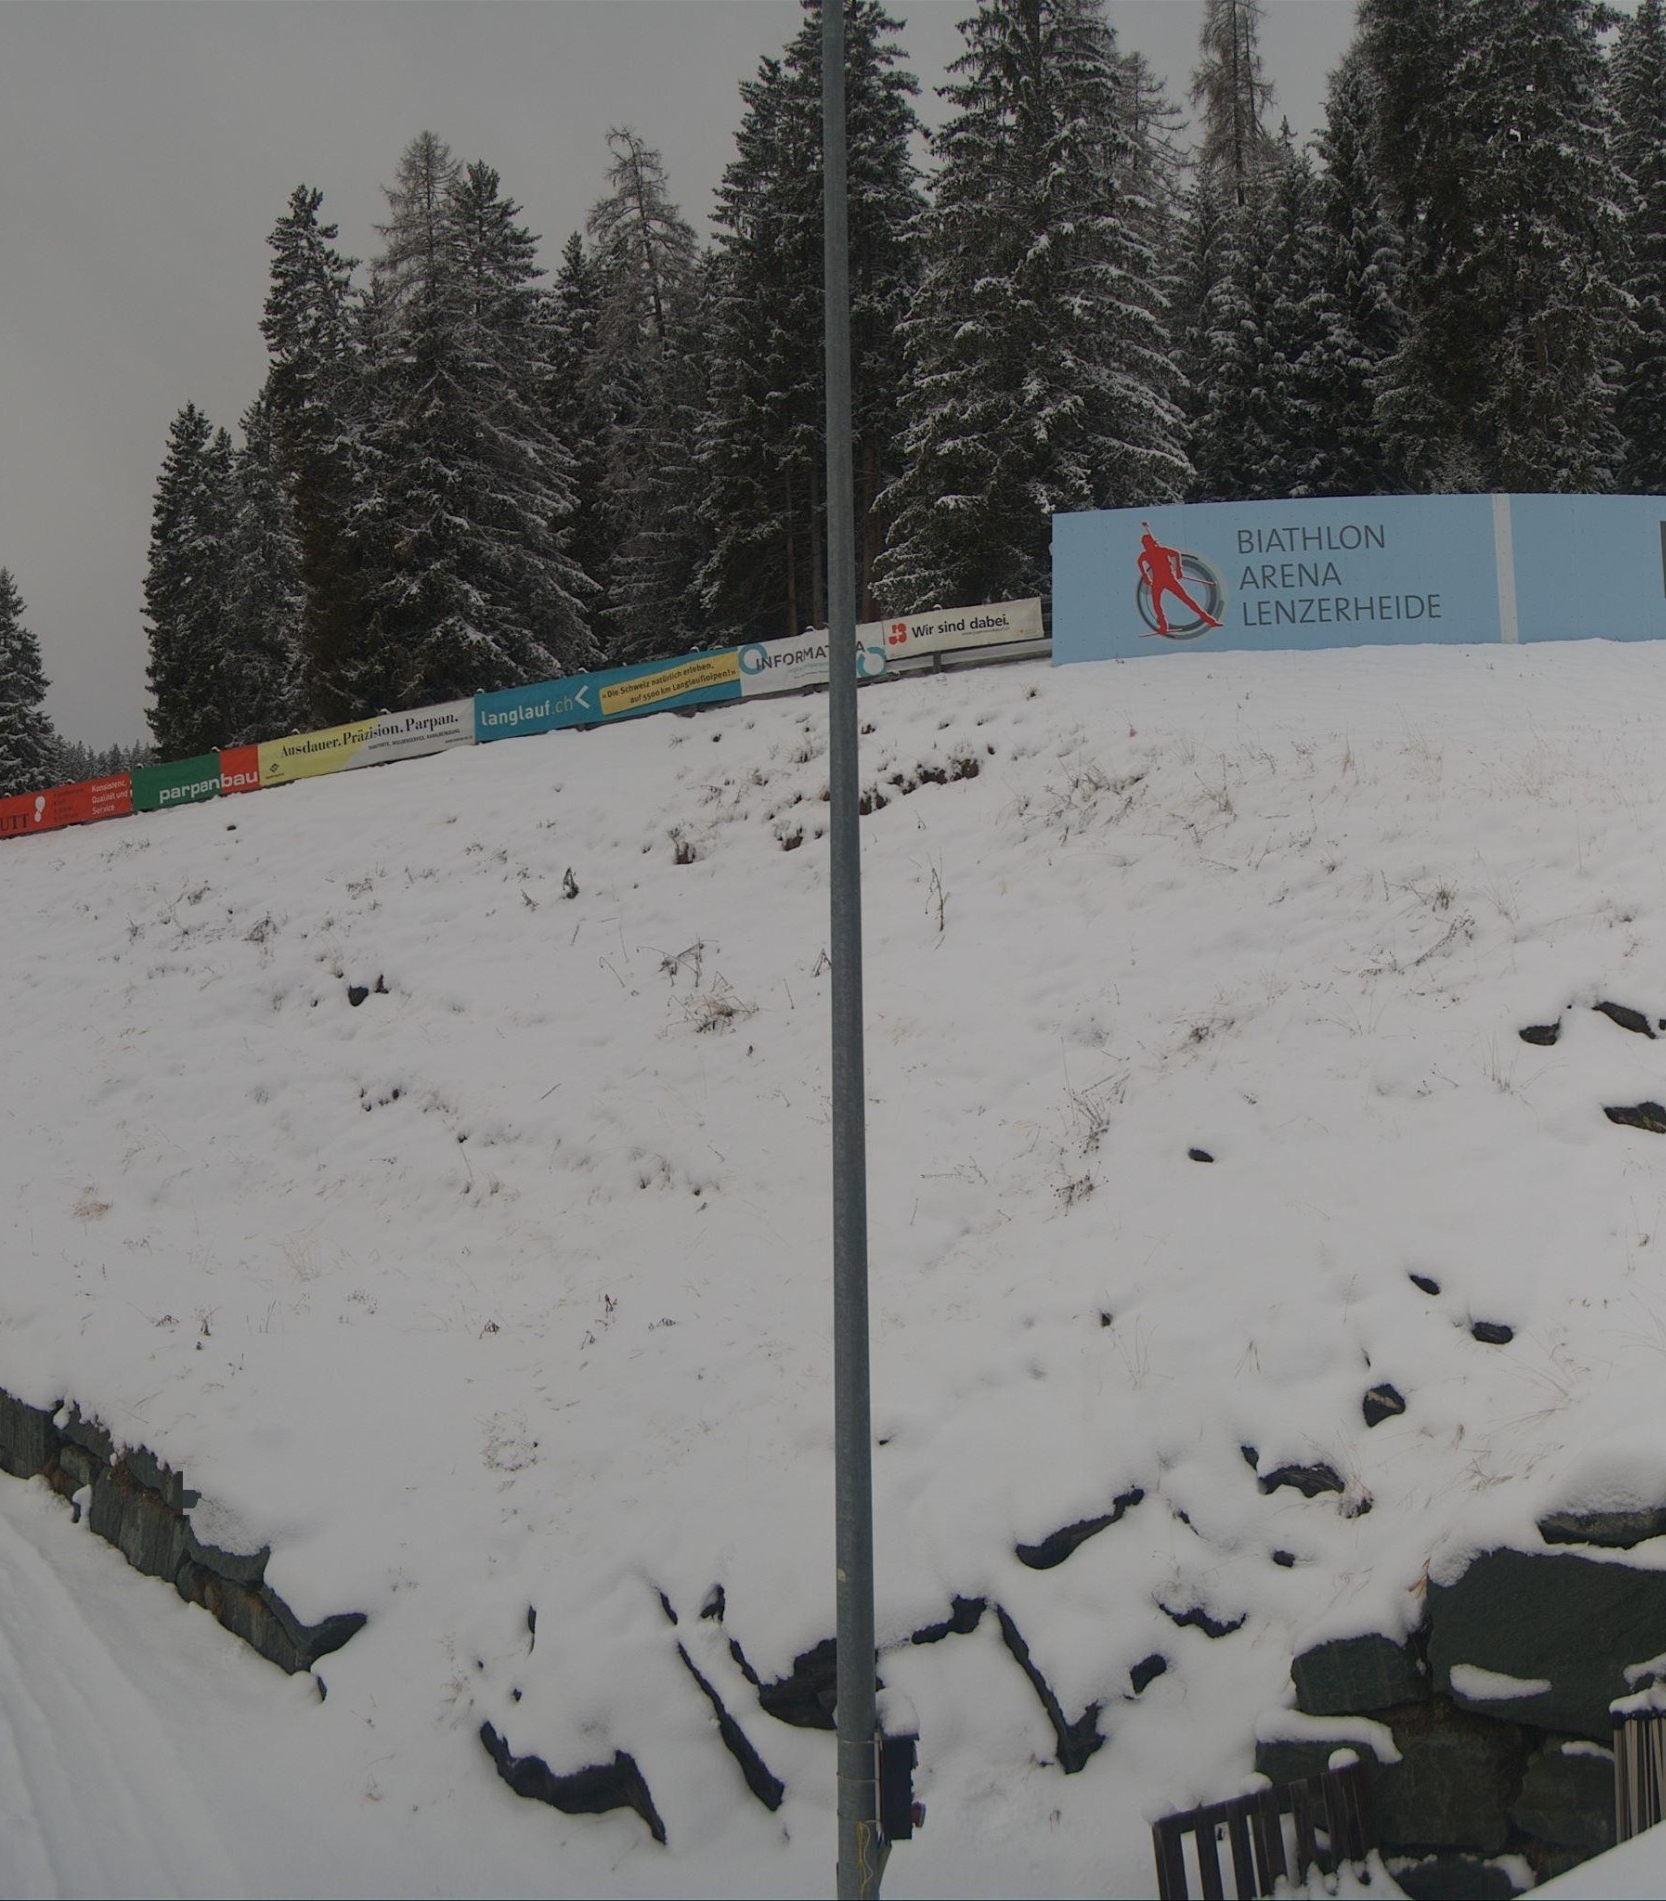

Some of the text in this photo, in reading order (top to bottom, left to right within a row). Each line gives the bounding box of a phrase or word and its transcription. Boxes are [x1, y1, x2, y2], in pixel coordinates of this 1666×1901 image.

[1237, 524, 1386, 554] BIATHLON
[1240, 562, 1342, 590] ARENA
[1243, 594, 1442, 626] LENZERHEIDE
[911, 623, 934, 638] Wir
[938, 619, 965, 634] sind
[970, 614, 1009, 630] dabei.
[620, 681, 650, 697] Schweiz
[651, 671, 681, 689] natürlich
[630, 693, 641, 705] auf
[642, 688, 659, 702] 5500
[659, 685, 671, 696] km
[482, 695, 573, 726] langlauf.ch
[281, 736, 341, 758] Ausdauer.
[343, 724, 404, 746] Präzision.
[405, 712, 458, 733] Parpan.
[116, 790, 128, 799] und
[159, 771, 258, 804] parpanbau
[92, 805, 115, 815] Service
